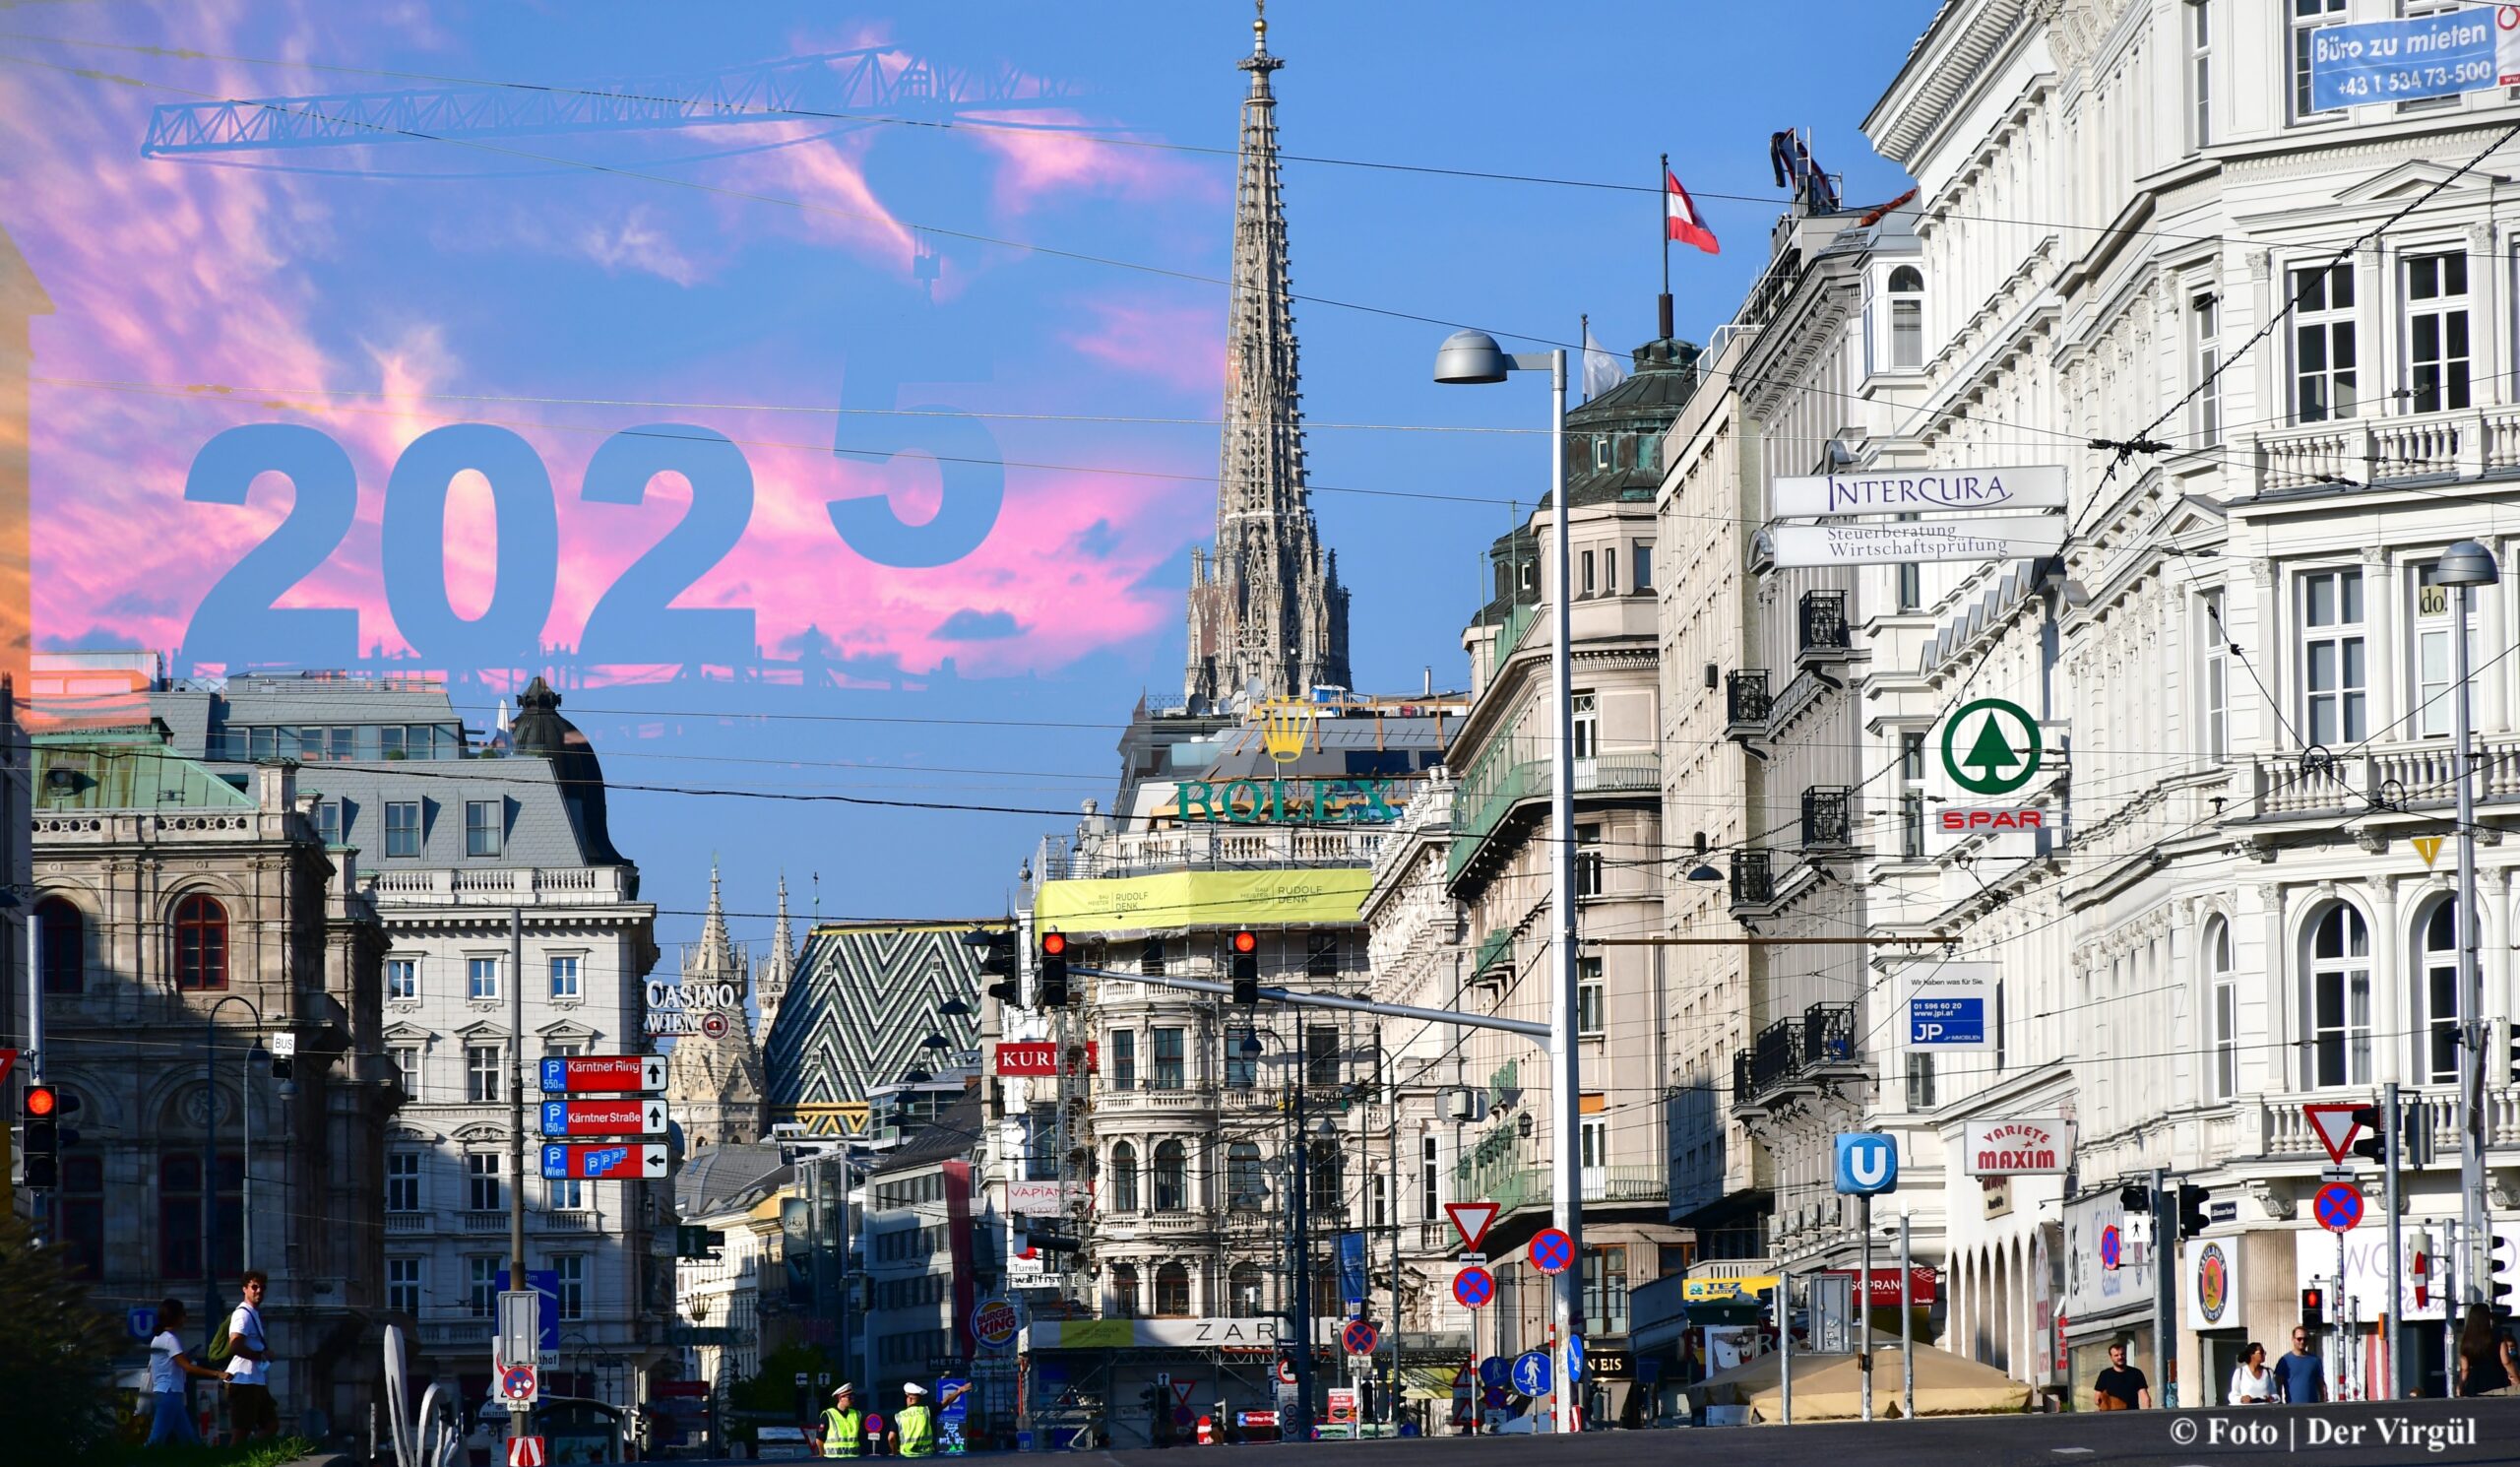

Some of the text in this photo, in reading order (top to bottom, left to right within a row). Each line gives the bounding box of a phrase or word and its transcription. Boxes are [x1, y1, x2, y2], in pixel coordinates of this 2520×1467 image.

[2316, 23, 2487, 64] Büro zu mieten
[2338, 60, 2491, 96] +43 1 534 73-500
[1828, 524, 1957, 542] Steuerberatung
[1830, 537, 2008, 559] Wirtschaftsprüfung
[1175, 780, 1397, 823] ROLEX
[1942, 810, 2043, 829] SPAR
[1115, 891, 1149, 902] RUDOLF
[1278, 885, 1323, 894] RUDOLF
[1115, 902, 1138, 911] DENK
[1278, 895, 1308, 904] DENK
[646, 980, 734, 1009] CASINO
[647, 1013, 696, 1033] WIEN
[1914, 1023, 1943, 1042] JP
[276, 1038, 293, 1050] BUS
[568, 1060, 613, 1073] Kärntner
[615, 1059, 640, 1073] Ring
[1002, 1051, 1091, 1067] KURI
[568, 1112, 608, 1123] Kärntner
[609, 1112, 641, 1122] Straße
[1983, 1124, 2050, 1144] VARIETE
[1852, 1146, 1886, 1185] U
[1978, 1149, 2055, 1170] MAXIM
[544, 1166, 566, 1177] Wien
[1013, 1263, 1040, 1273] Turek
[1539, 1266, 1565, 1275] ANFANG
[1852, 1279, 1904, 1291] SOPRAN
[976, 1307, 1014, 1326] BURGER
[978, 1315, 1016, 1338] KING
[1196, 1322, 1275, 1341] ZAR
[1603, 1357, 1622, 1371] EIS
